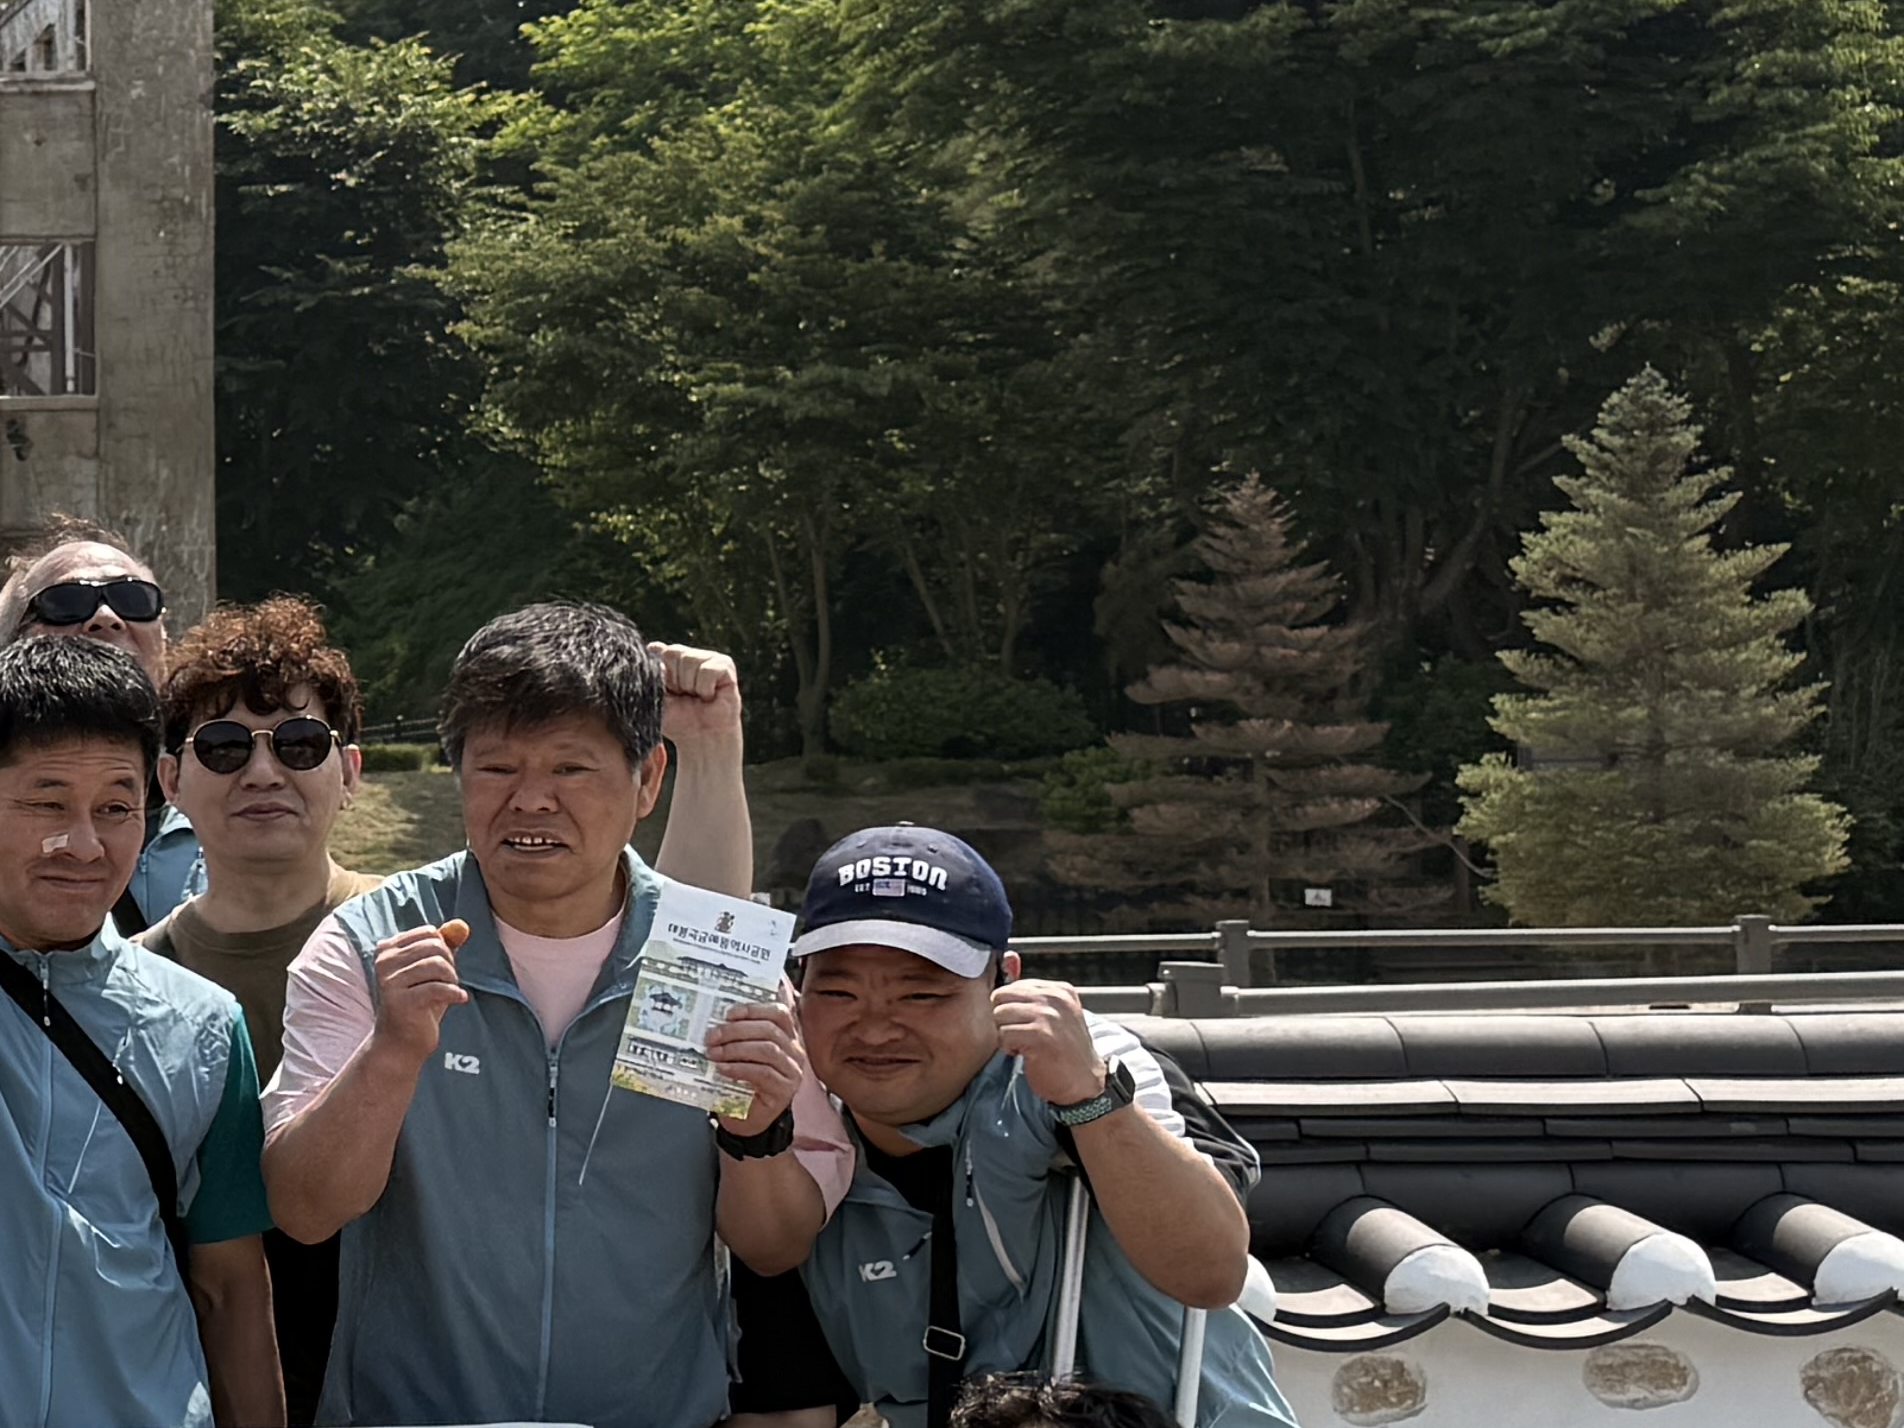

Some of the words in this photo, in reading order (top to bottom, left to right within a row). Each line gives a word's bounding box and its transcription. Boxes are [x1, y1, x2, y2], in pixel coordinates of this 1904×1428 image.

[838, 856, 948, 891] BOSTON
[444, 1052, 480, 1074] K2
[858, 1260, 897, 1282] K2
